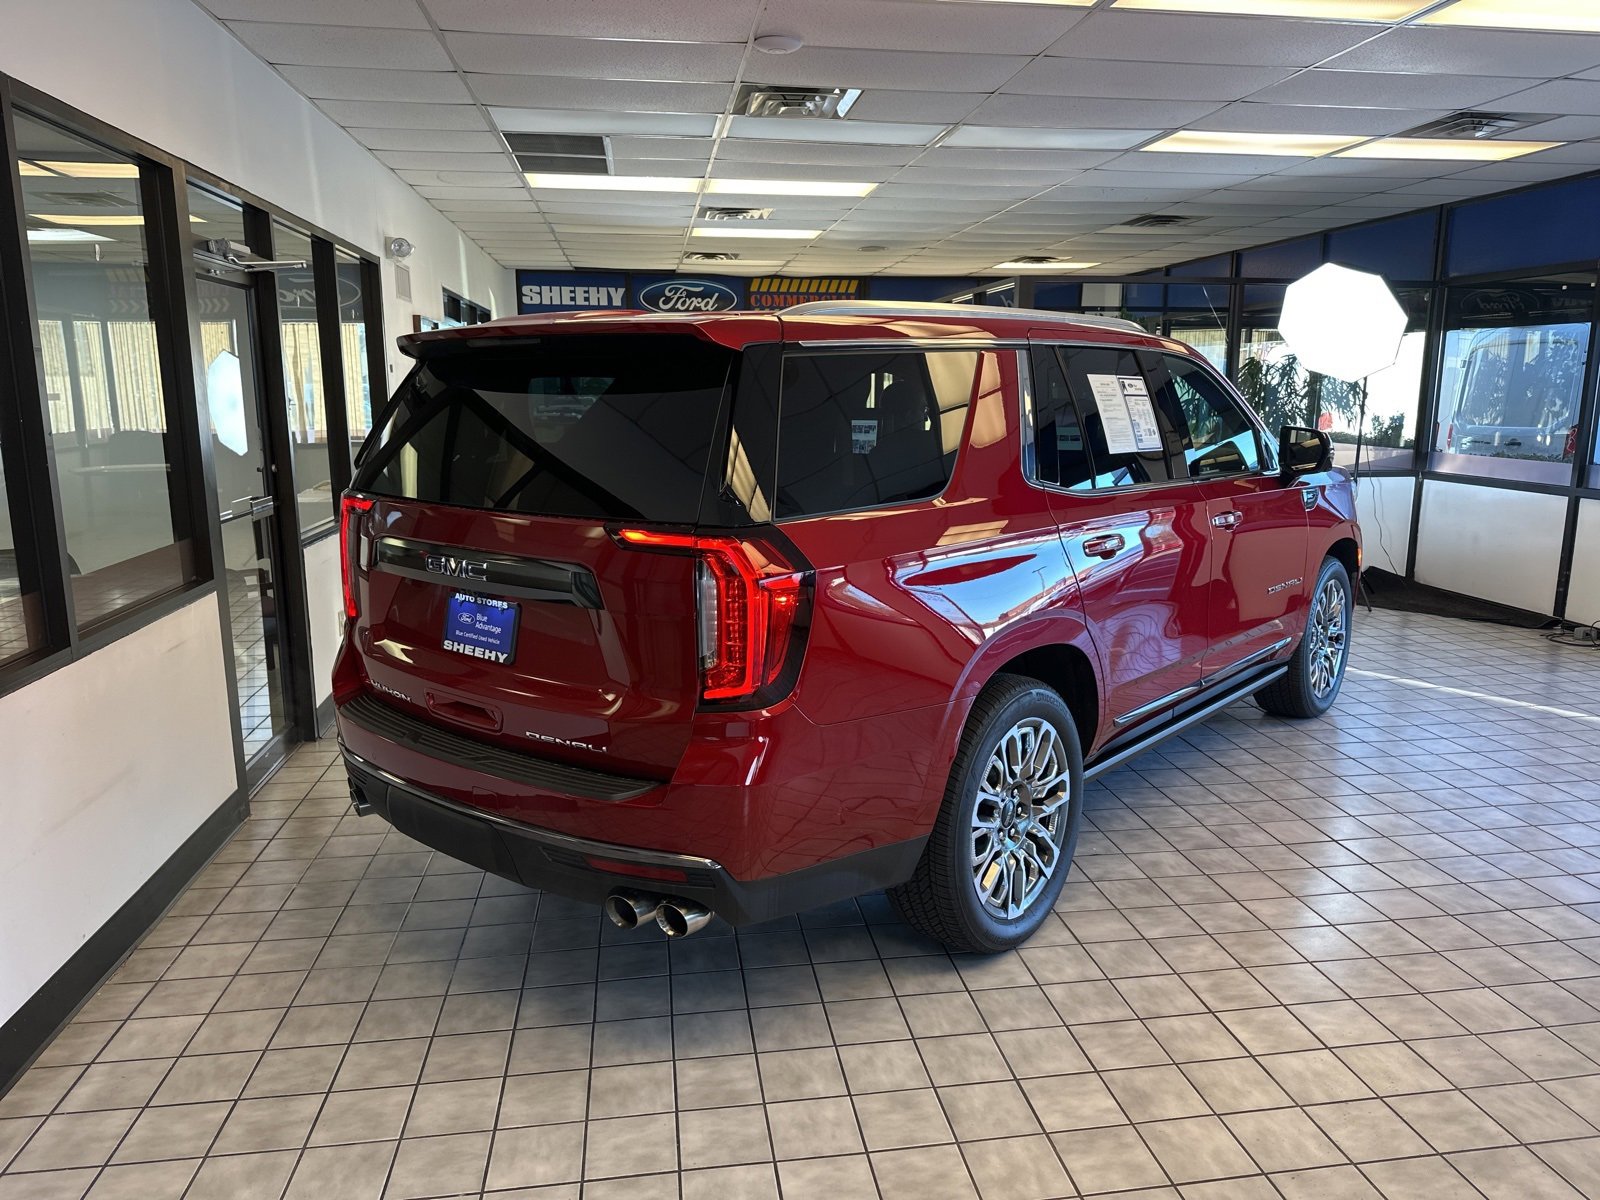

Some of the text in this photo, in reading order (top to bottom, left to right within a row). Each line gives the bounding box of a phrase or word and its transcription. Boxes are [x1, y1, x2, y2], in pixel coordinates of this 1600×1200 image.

[521, 285, 626, 307] SHEEHY
[658, 284, 719, 312] Ford
[425, 554, 488, 582] GMC
[1267, 577, 1303, 595] DENALI
[455, 593, 508, 608] AUTO STORES
[476, 613, 488, 622] Blue
[464, 632, 478, 640] Certified
[488, 636, 500, 644] Vehicle
[476, 622, 502, 634] Advantage
[443, 639, 508, 664] SHEEHY
[525, 731, 608, 753] DENALI
